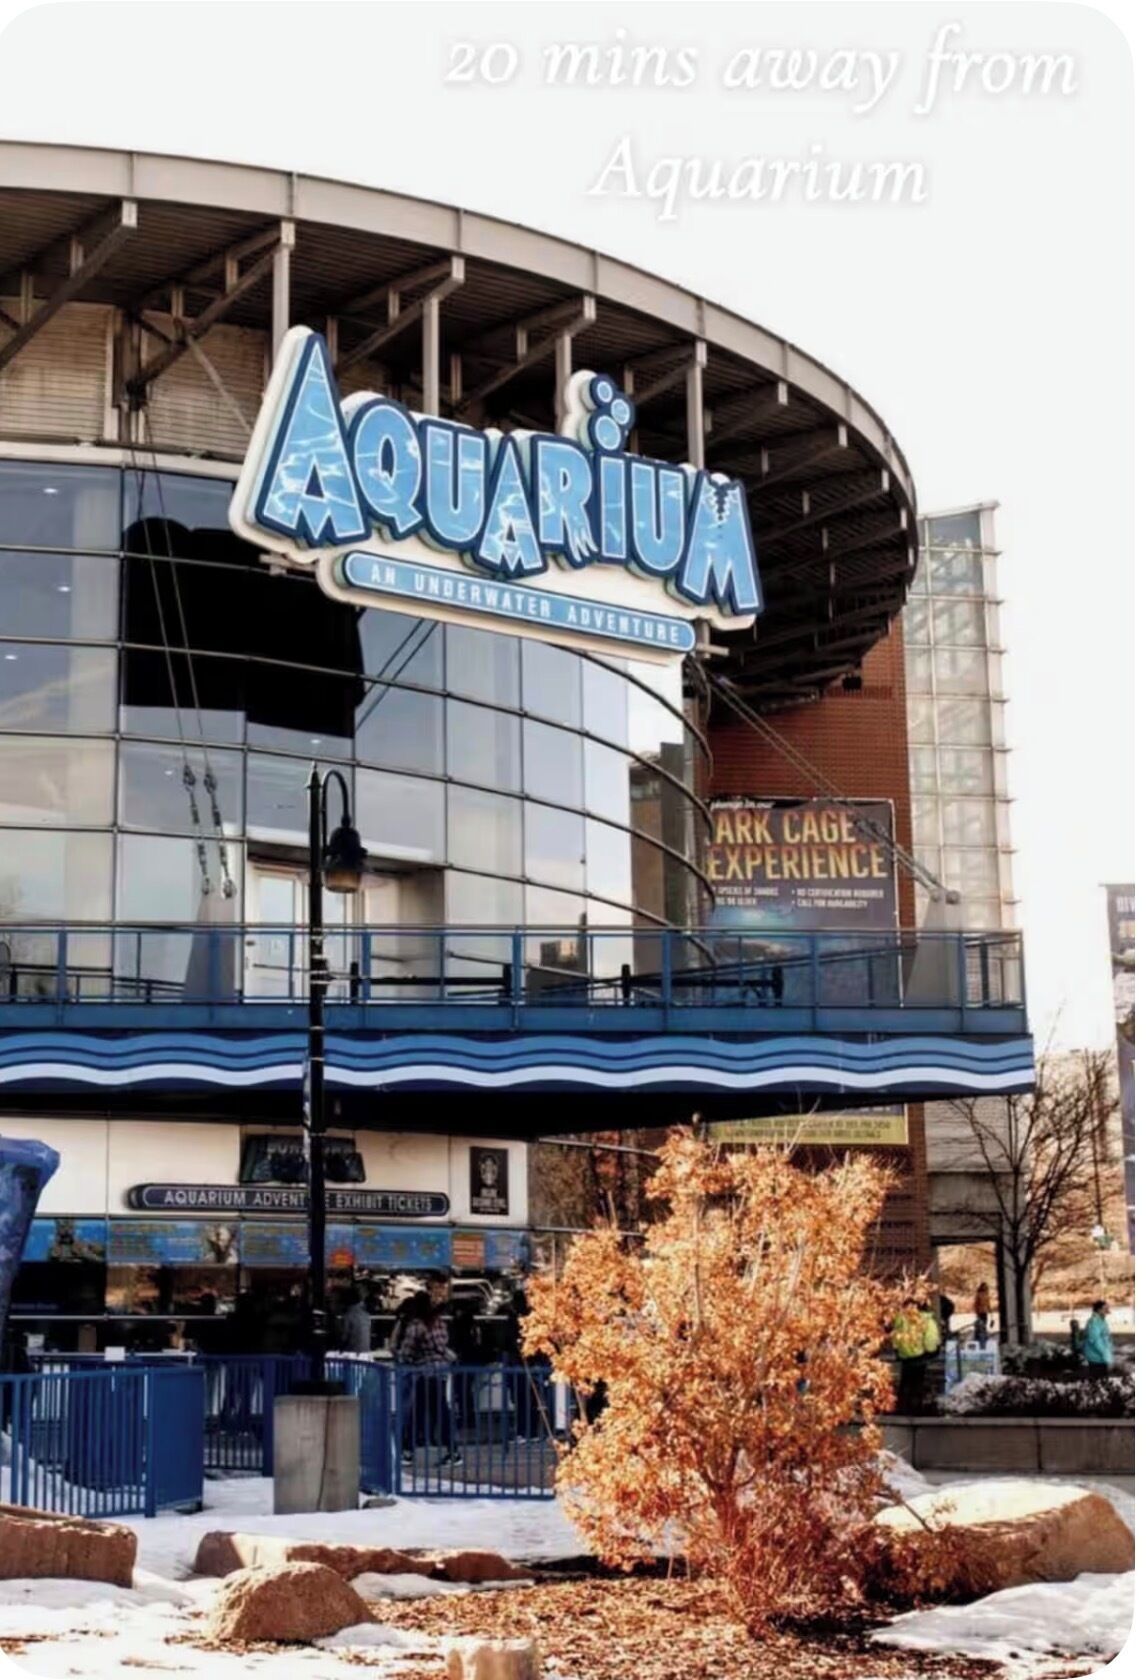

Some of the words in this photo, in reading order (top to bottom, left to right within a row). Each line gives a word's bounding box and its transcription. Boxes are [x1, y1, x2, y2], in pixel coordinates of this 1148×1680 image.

[257, 333, 762, 614] AQUARIUM
[370, 564, 396, 586] AN
[413, 573, 551, 618] UNDERWATER
[566, 605, 680, 644] ADVENTURE
[783, 809, 857, 843] CAGE
[707, 844, 888, 880] EXPERIENCE
[164, 1190, 246, 1206] AQUARIUM
[253, 1191, 330, 1208] ADVENTE
[335, 1193, 383, 1209] EXHIBIT
[387, 1195, 432, 1211] TICKETS
